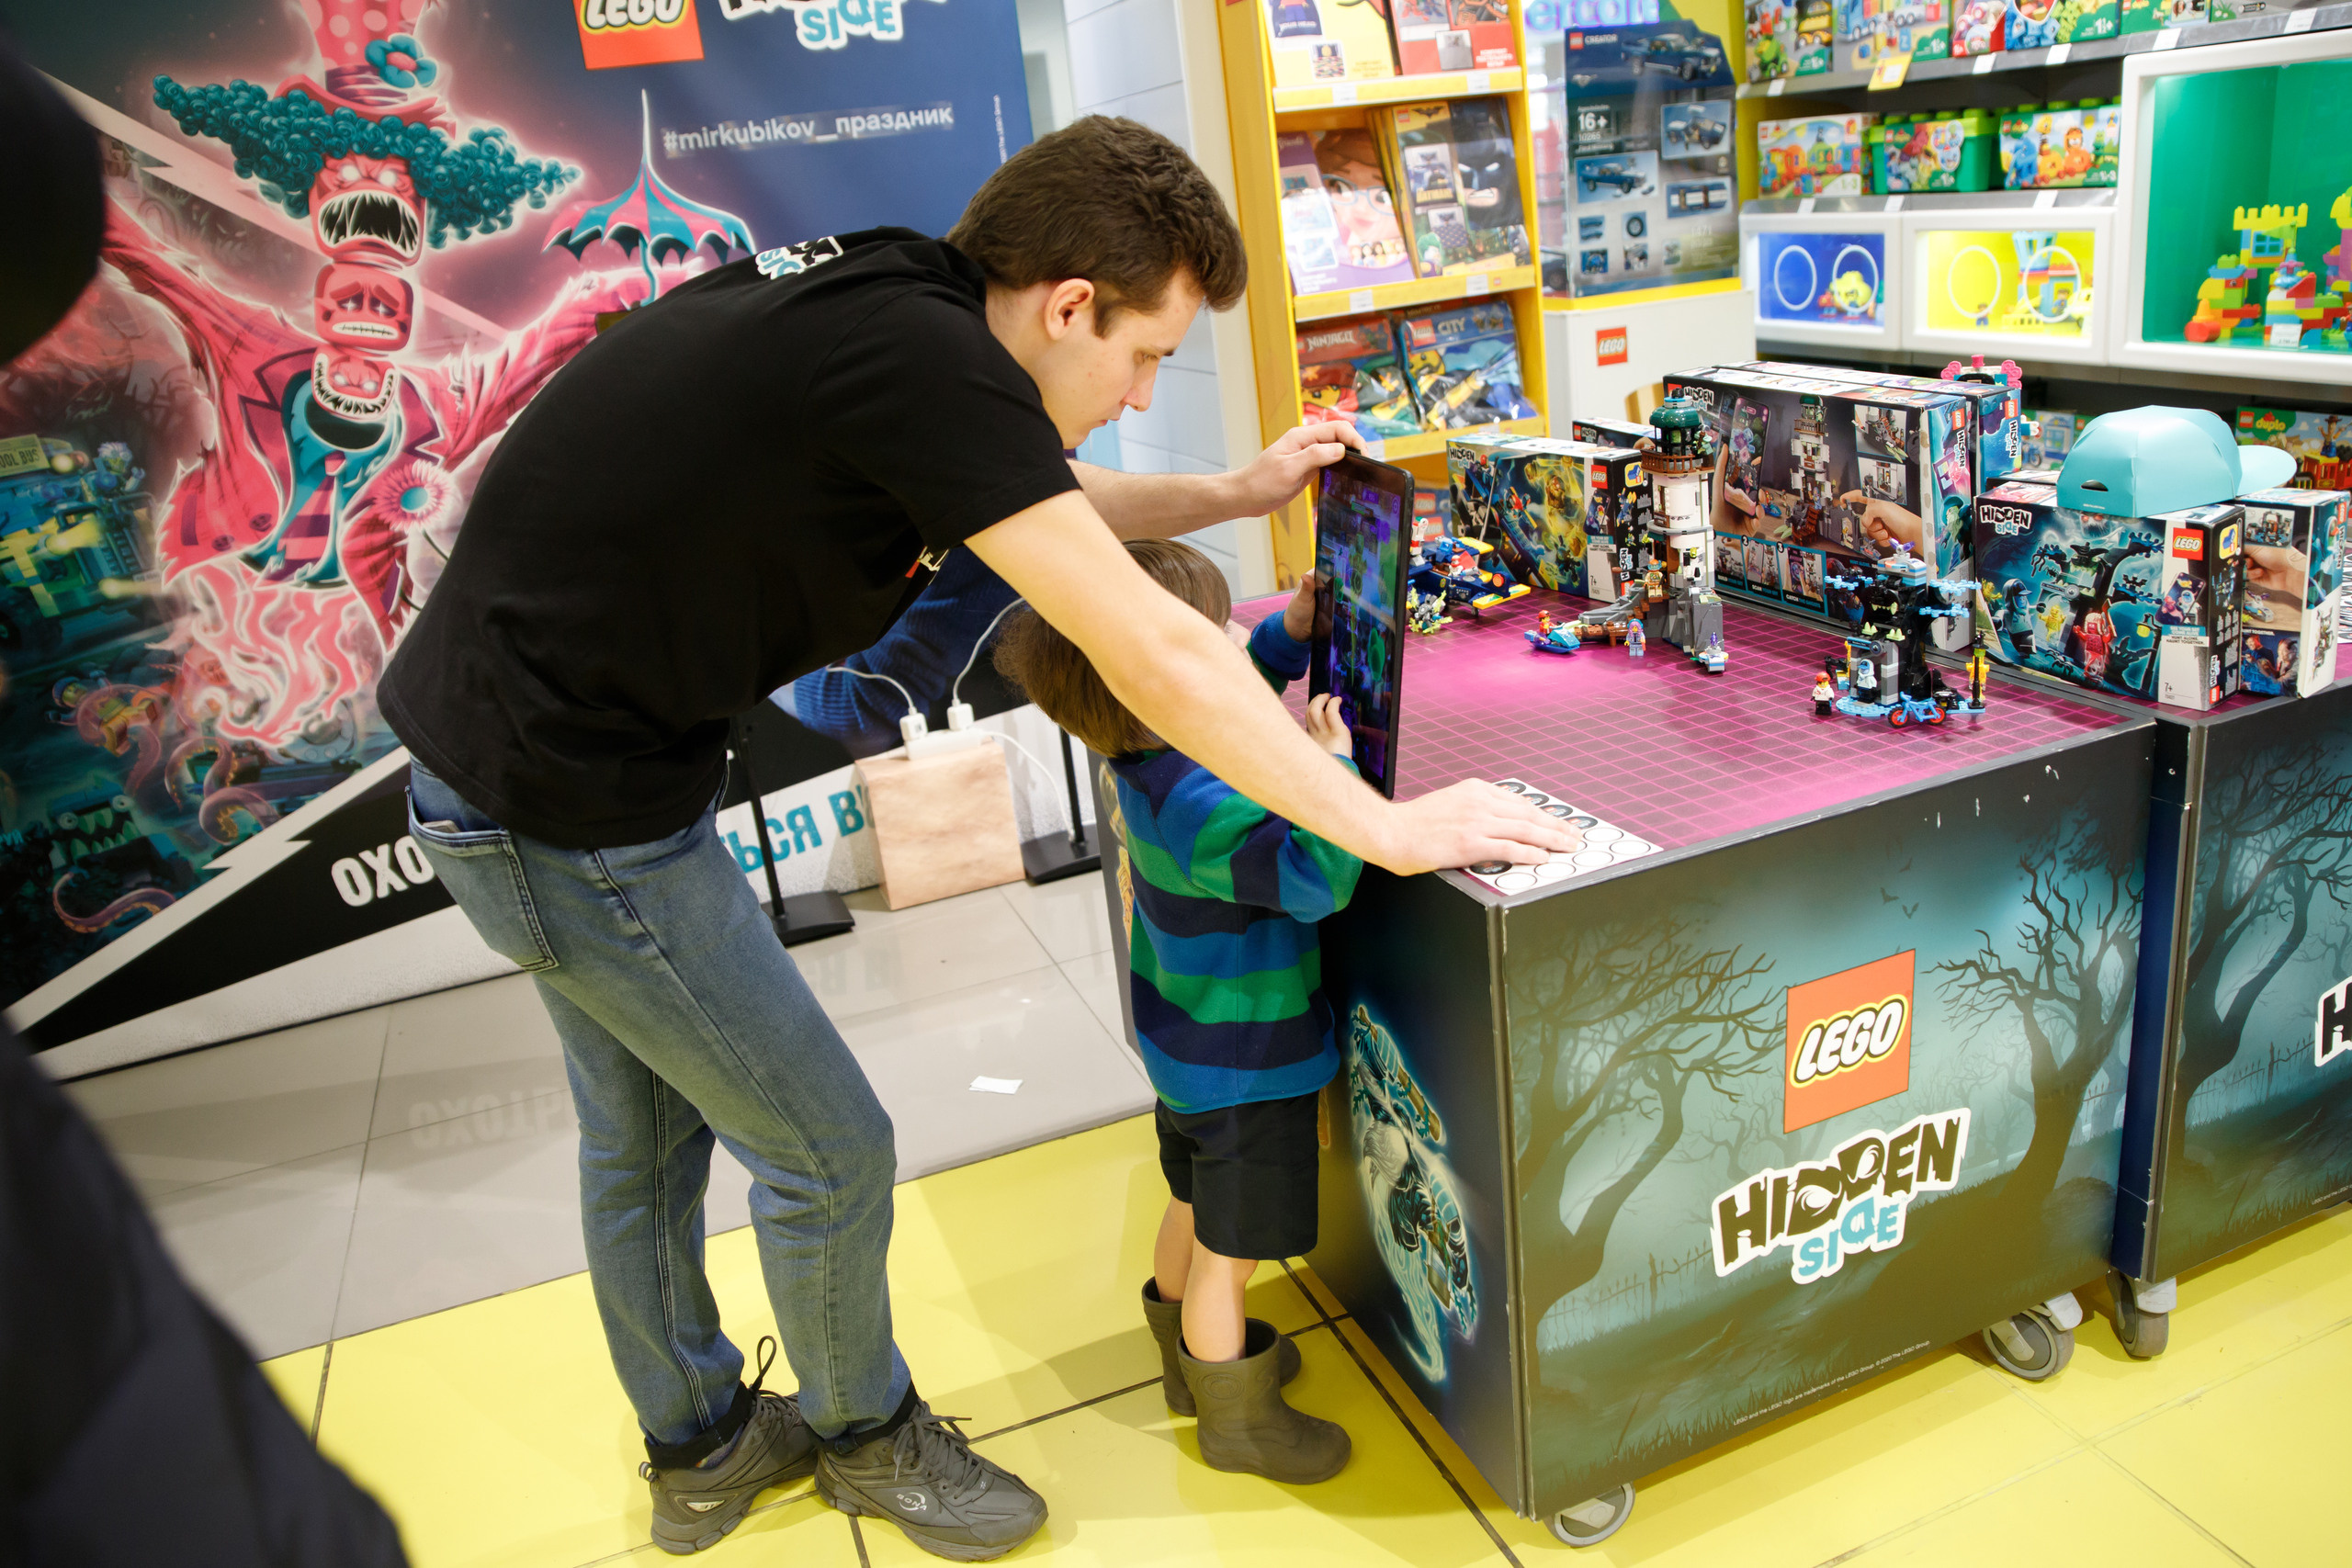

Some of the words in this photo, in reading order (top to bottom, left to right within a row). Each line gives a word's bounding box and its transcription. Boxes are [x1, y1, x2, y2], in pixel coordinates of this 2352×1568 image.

[663, 105, 954, 151] #mirkubikov_праздник
[1578, 112, 1608, 130] 16+
[1438, 317, 1465, 335] CITY
[1306, 330, 1357, 351] NINJAGO
[1599, 337, 1625, 355] LEGO
[1683, 386, 1714, 406] HIDDEN
[2256, 417, 2286, 432] duplo
[2009, 420, 2018, 457] HIDDEN
[18, 448, 40, 465] BUS
[1449, 446, 1476, 461] HIDDEN
[1957, 430, 1965, 468] HIDDEN
[1980, 504, 2032, 530] HIDDEN
[1996, 522, 2018, 535] SIDE
[2174, 536, 2201, 551] LEGO
[1590, 575, 1597, 586] 7+
[2165, 682, 2173, 692] 7+
[719, 804, 823, 874] ЬСЯ
[1794, 998, 1905, 1083] LEGO
[1715, 1112, 1964, 1271] HIDDEN
[1797, 1196, 1901, 1278] SIDE
[1733, 1416, 1748, 1426] LEGO
[1769, 1401, 1783, 1411] LEGO
[1804, 1382, 1830, 1396] trademarks
[1845, 1369, 1860, 1379] LEGO
[1901, 1346, 1916, 1356] LEGO
